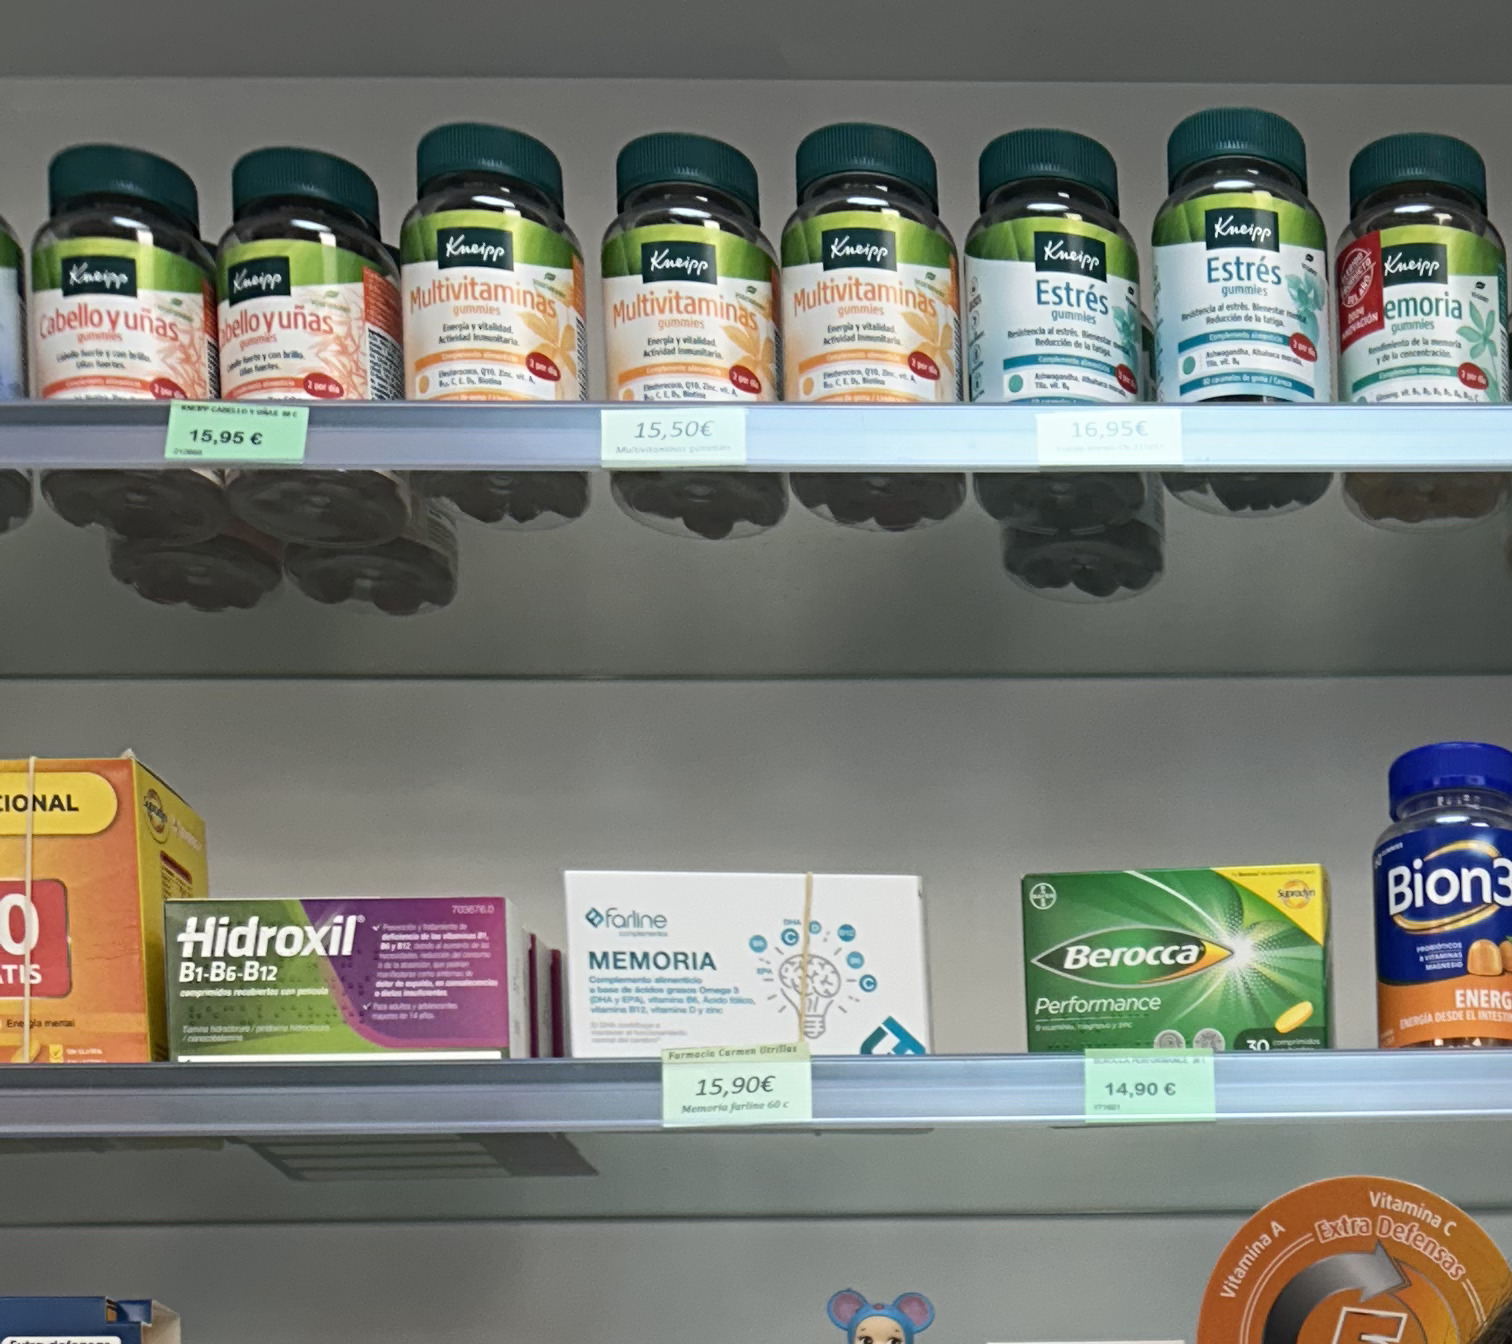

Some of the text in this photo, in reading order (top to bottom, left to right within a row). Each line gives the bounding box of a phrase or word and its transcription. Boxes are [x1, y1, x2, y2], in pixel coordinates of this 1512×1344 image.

[445, 235, 506, 259] Kneipp
[1043, 240, 1101, 269] Kneipp
[649, 250, 709, 276] Kneipp
[409, 278, 557, 320] Multivitaminas
[1035, 278, 1109, 315] Estrés
[39, 302, 179, 341] Cabello y uñas
[612, 289, 758, 332] Multivitaminas
[1051, 310, 1096, 325] gummies
[189, 429, 264, 446] 15,95 €
[634, 419, 714, 441] 15,50€
[605, 907, 668, 929] farline
[177, 915, 358, 958] Hidroxil
[588, 951, 717, 971] MEMORIA
[1063, 944, 1199, 971] Berocca
[1035, 995, 1162, 1016] Performance
[1400, 1013, 1431, 1030] ENERGÍA
[1434, 1010, 1462, 1025] DESDE
[1465, 1010, 1476, 1024] EL
[695, 1075, 776, 1097] 15,90€
[1105, 1081, 1176, 1098] 14,90 €
[1369, 1191, 1457, 1237] Vitamina C
[1220, 1220, 1286, 1299] Vitamina A
[1314, 1215, 1467, 1281] Extra Defensas
